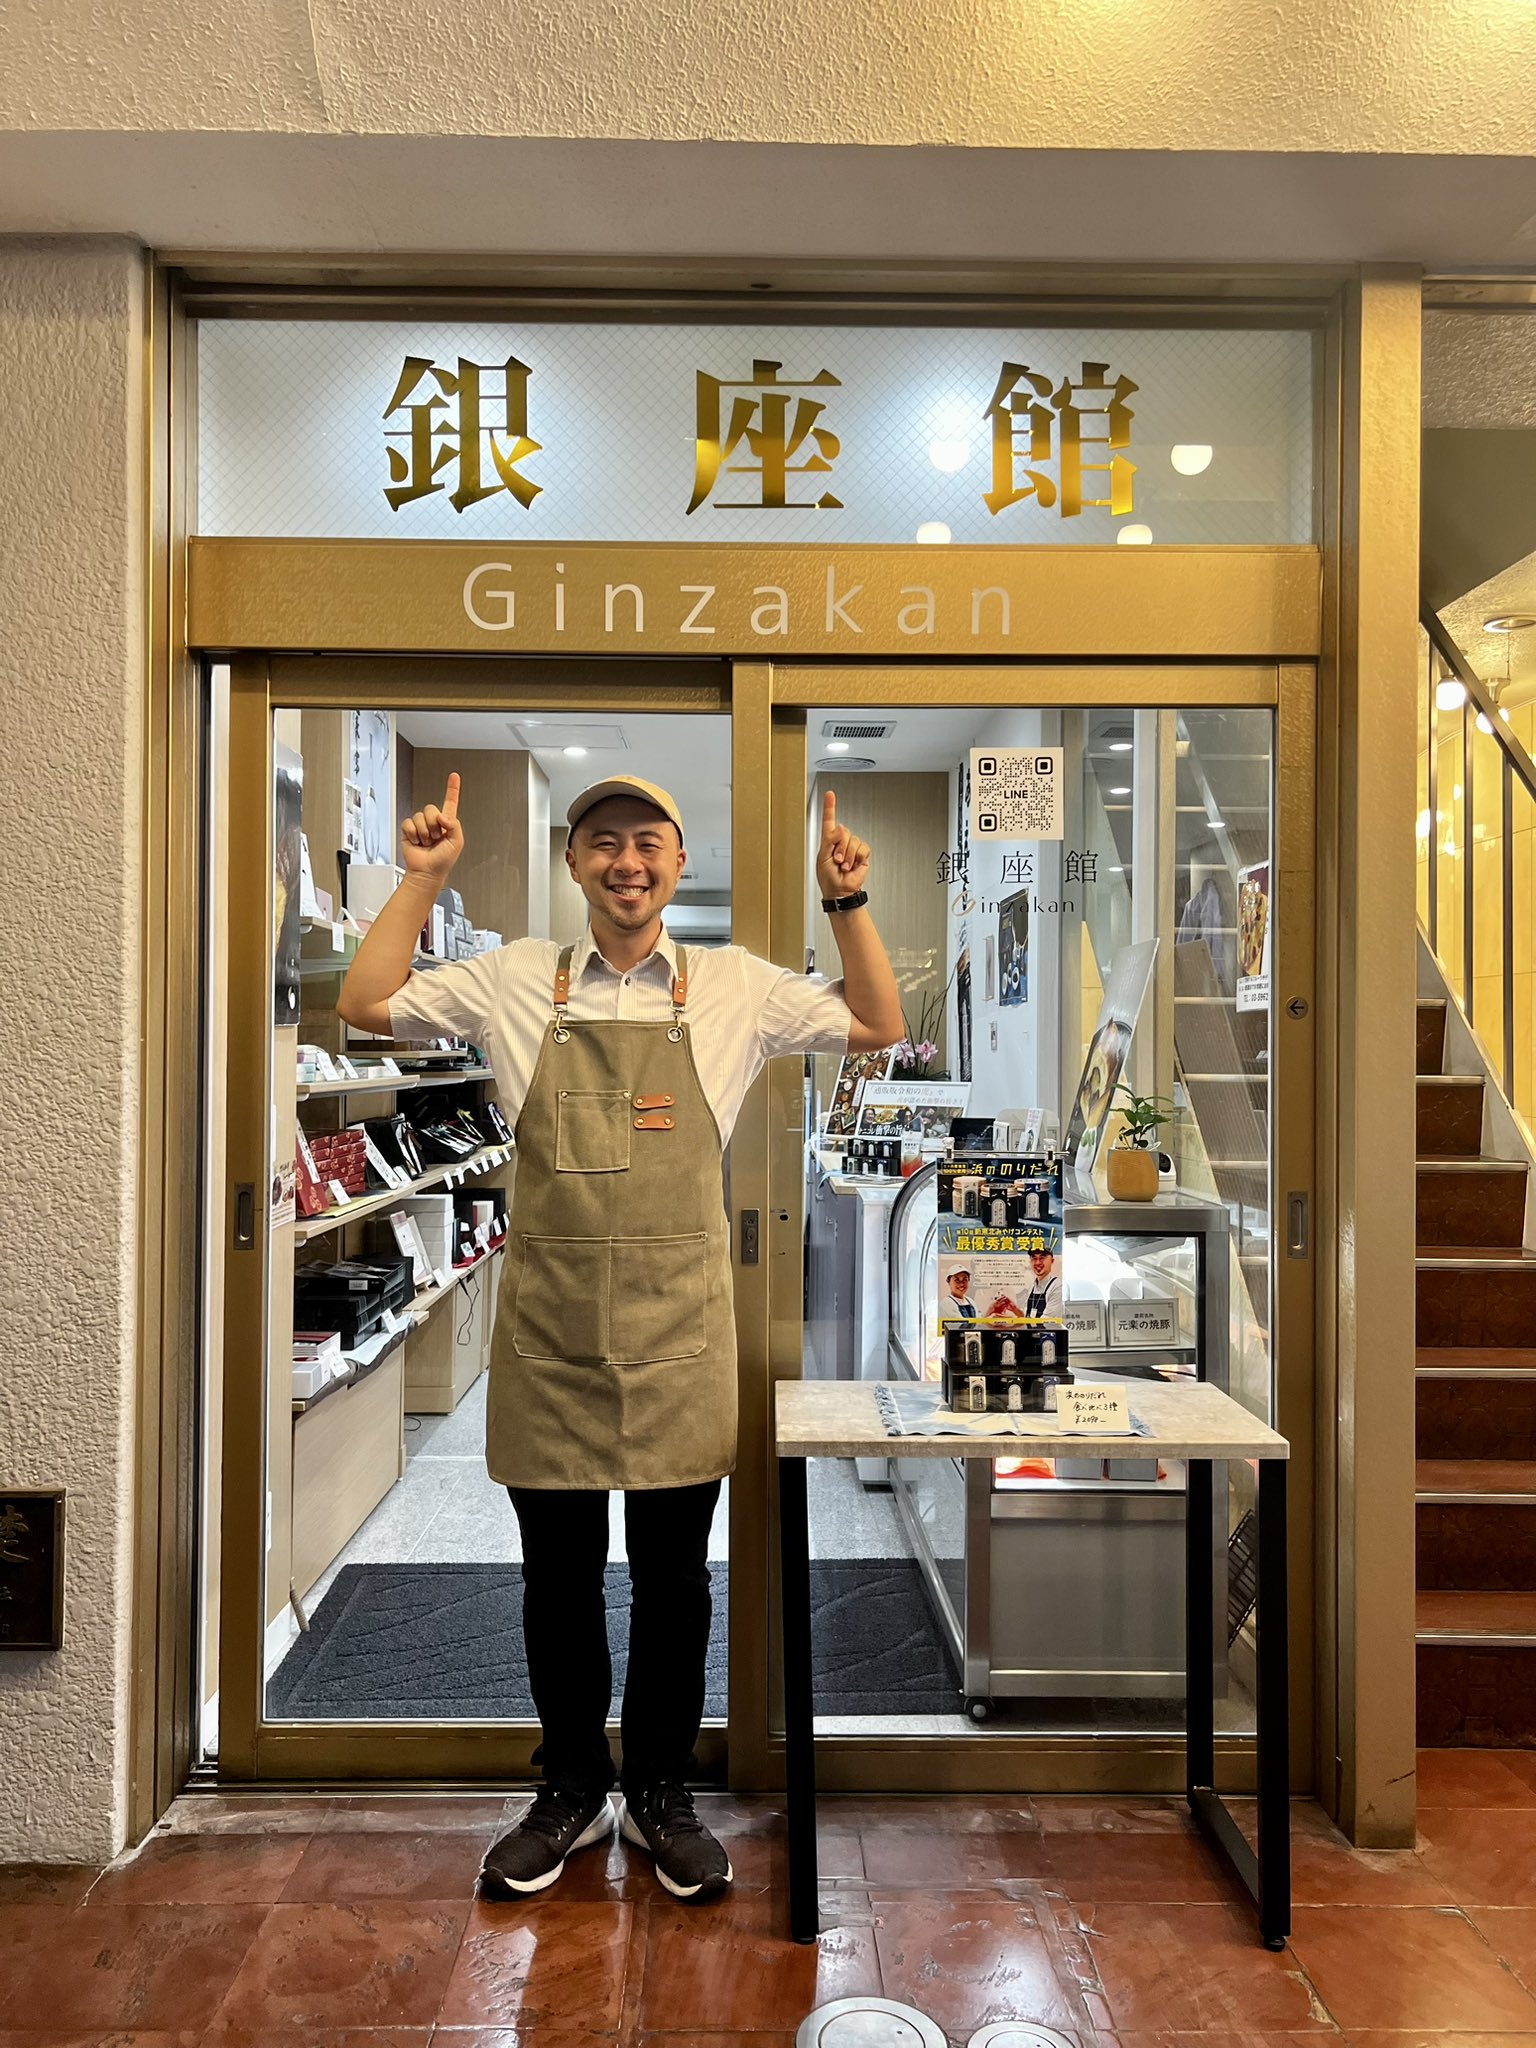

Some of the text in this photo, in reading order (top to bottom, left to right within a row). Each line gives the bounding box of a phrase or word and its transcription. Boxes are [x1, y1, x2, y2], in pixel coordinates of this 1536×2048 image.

[383, 355, 1140, 518] 銀座館
[463, 562, 1013, 636] Ginzakan
[1003, 789, 1029, 800] LINE
[936, 850, 1099, 885] 銀座館
[1117, 1318, 1172, 1332] 元楽の焼豚
